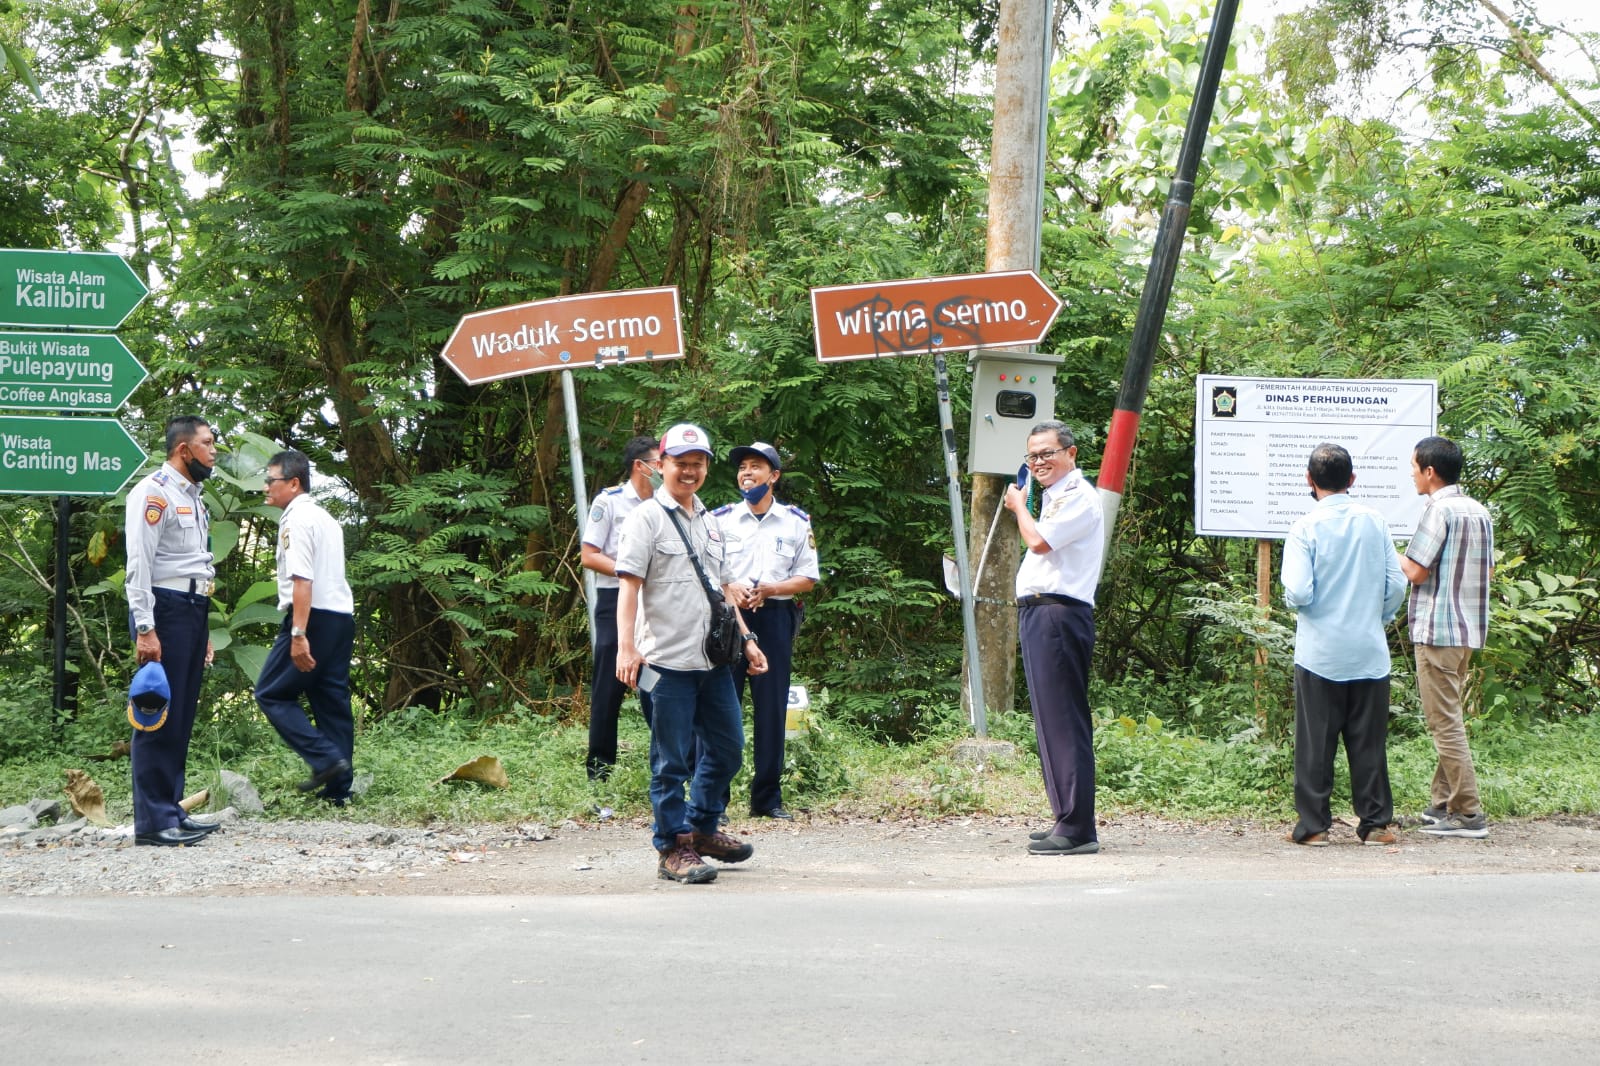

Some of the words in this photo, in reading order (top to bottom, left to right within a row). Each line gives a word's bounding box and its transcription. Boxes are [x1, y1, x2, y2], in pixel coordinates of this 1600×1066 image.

[16, 269, 65, 285] Wisata
[68, 271, 105, 286] Alam
[16, 284, 105, 309] Kalibiru
[835, 306, 927, 336] Wisma
[941, 299, 1027, 327] Sermo
[471, 320, 560, 358] Waduk
[573, 315, 661, 343] Sermo
[0, 341, 38, 356] Bukit
[41, 342, 90, 357] Wisata
[0, 356, 113, 382] Pulepayung
[0, 387, 46, 402] Coffee
[49, 388, 112, 407] Angkasa
[1255, 383, 1300, 391] PEMERINTAH
[1302, 384, 1345, 392] KABUPATEN
[1265, 394, 1299, 403] DINAS
[1302, 395, 1388, 405] PERHUBUNGAN
[2, 434, 51, 450] Wisata
[2, 450, 77, 474] Canting
[83, 452, 122, 471] Mas
